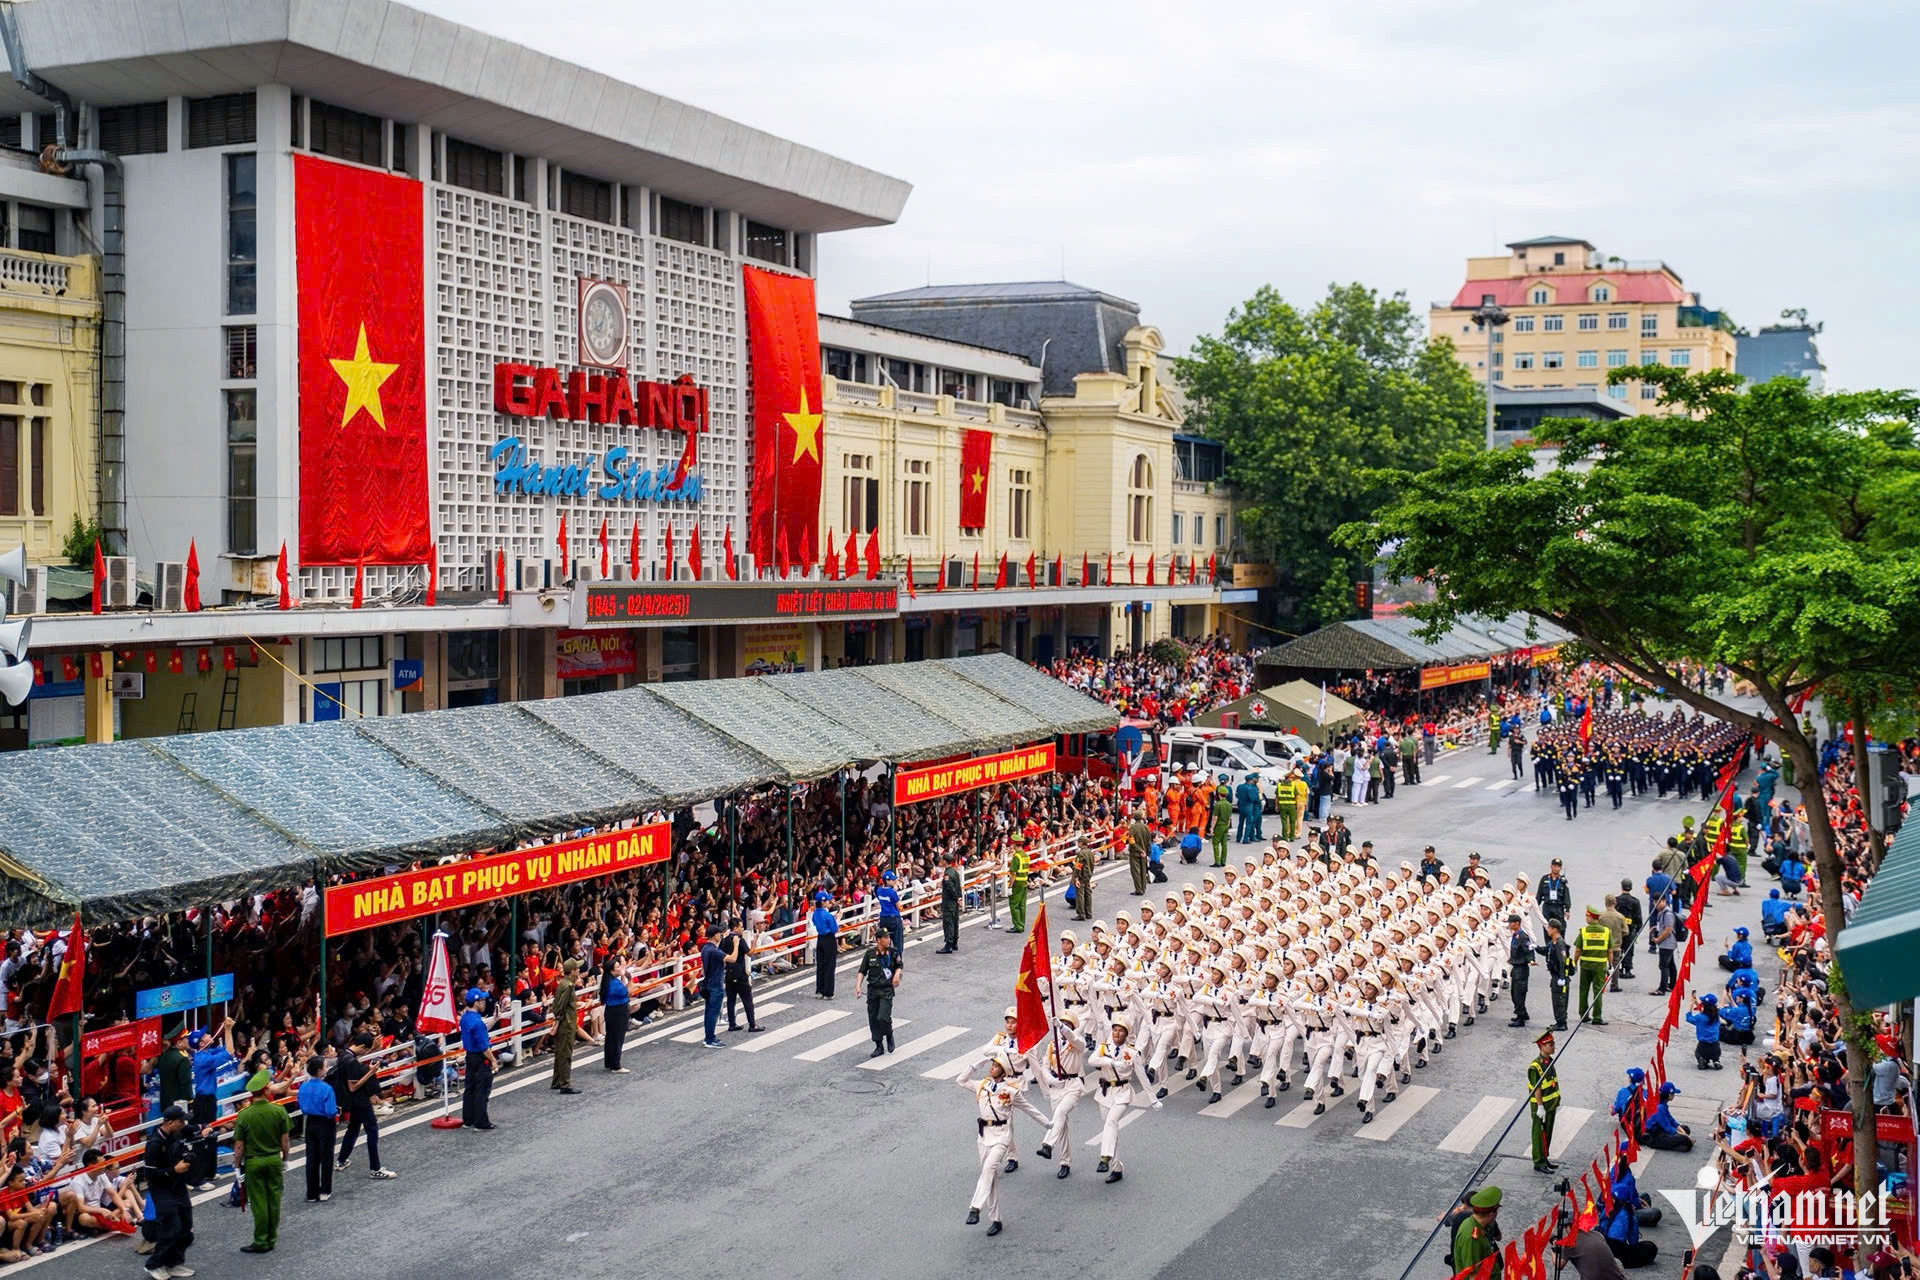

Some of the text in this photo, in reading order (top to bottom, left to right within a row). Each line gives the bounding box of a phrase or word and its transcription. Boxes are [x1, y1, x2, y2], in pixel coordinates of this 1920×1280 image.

[494, 363, 570, 419] GA
[568, 367, 638, 426] HÀ
[490, 436, 595, 497] Hanoi
[805, 588, 823, 616] LIỆT
[398, 669, 417, 679] ATM
[907, 751, 1047, 796] NHÀ BẠT PHỤC VỤ NHÂN DÂN
[354, 833, 654, 919] NHÀ BẠT PHỤC VỤ NHÂN DÂN
